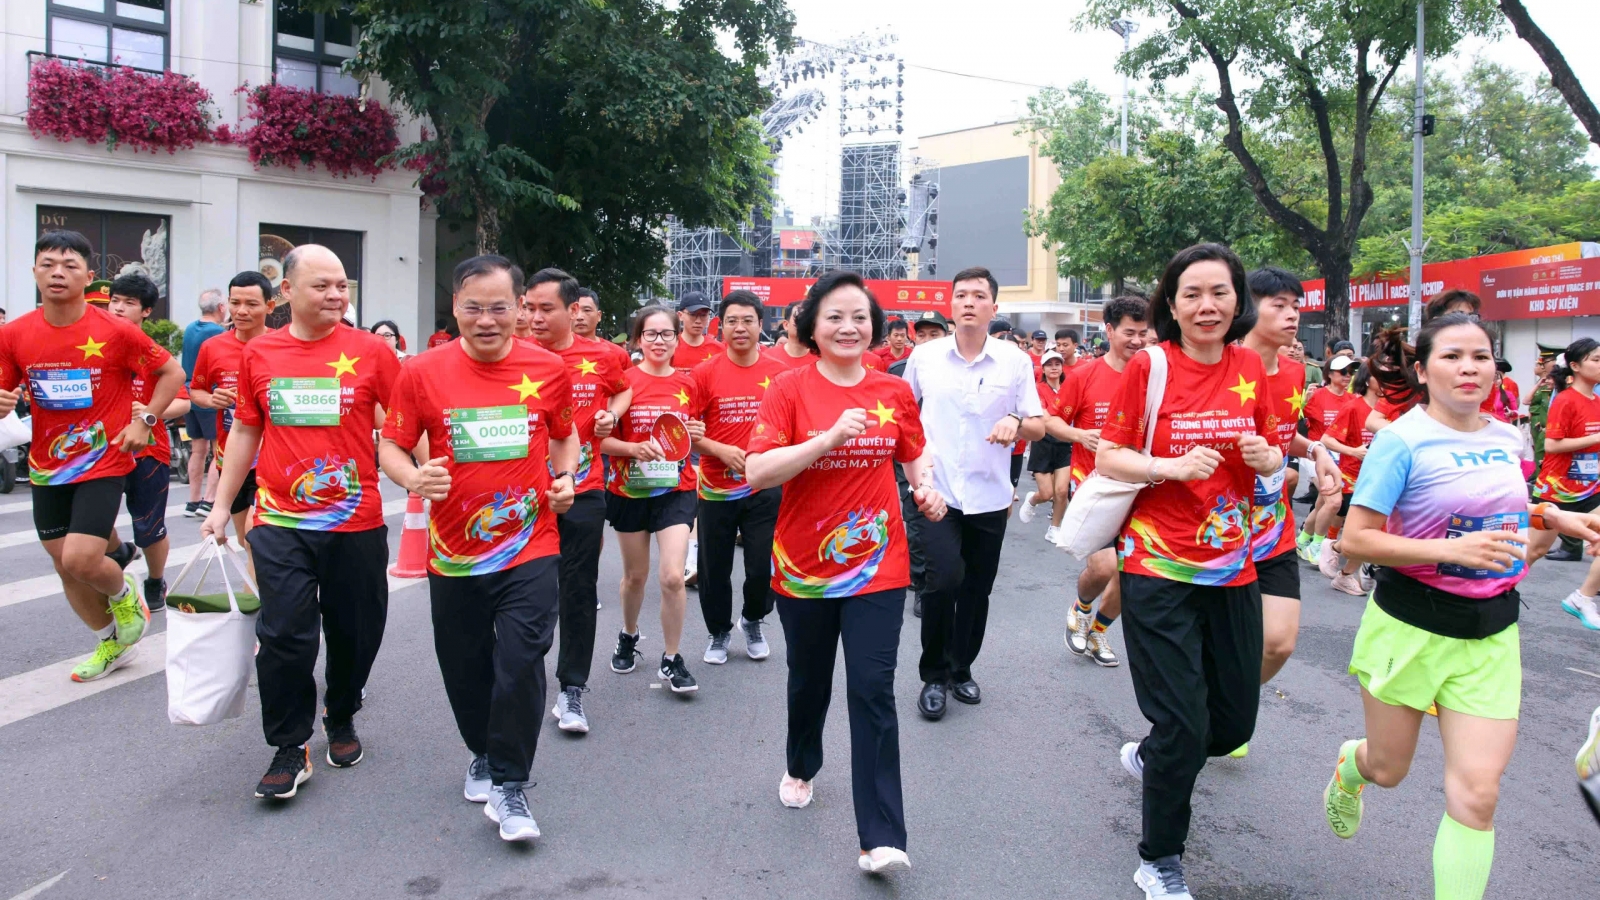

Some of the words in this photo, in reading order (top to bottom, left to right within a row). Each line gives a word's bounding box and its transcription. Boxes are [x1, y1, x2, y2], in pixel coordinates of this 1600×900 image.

[1529, 300, 1544, 312] KHO
[1546, 297, 1558, 313] SỰ
[1559, 295, 1578, 312] KIỆN
[52, 383, 88, 393] 51406
[293, 394, 337, 405] 38866
[633, 424, 653, 433] KHÔN
[1171, 420, 1201, 429] CHUNG
[1202, 418, 1219, 430] MỘT
[1221, 416, 1247, 428] QUYẾT
[1248, 416, 1256, 427] TÂ
[479, 424, 527, 438] 00002
[858, 435, 884, 447] QUYẾT
[1449, 448, 1514, 467] HYR
[647, 463, 676, 471] 33650
[808, 458, 847, 470] KHÔNG
[849, 459, 869, 468] MA
